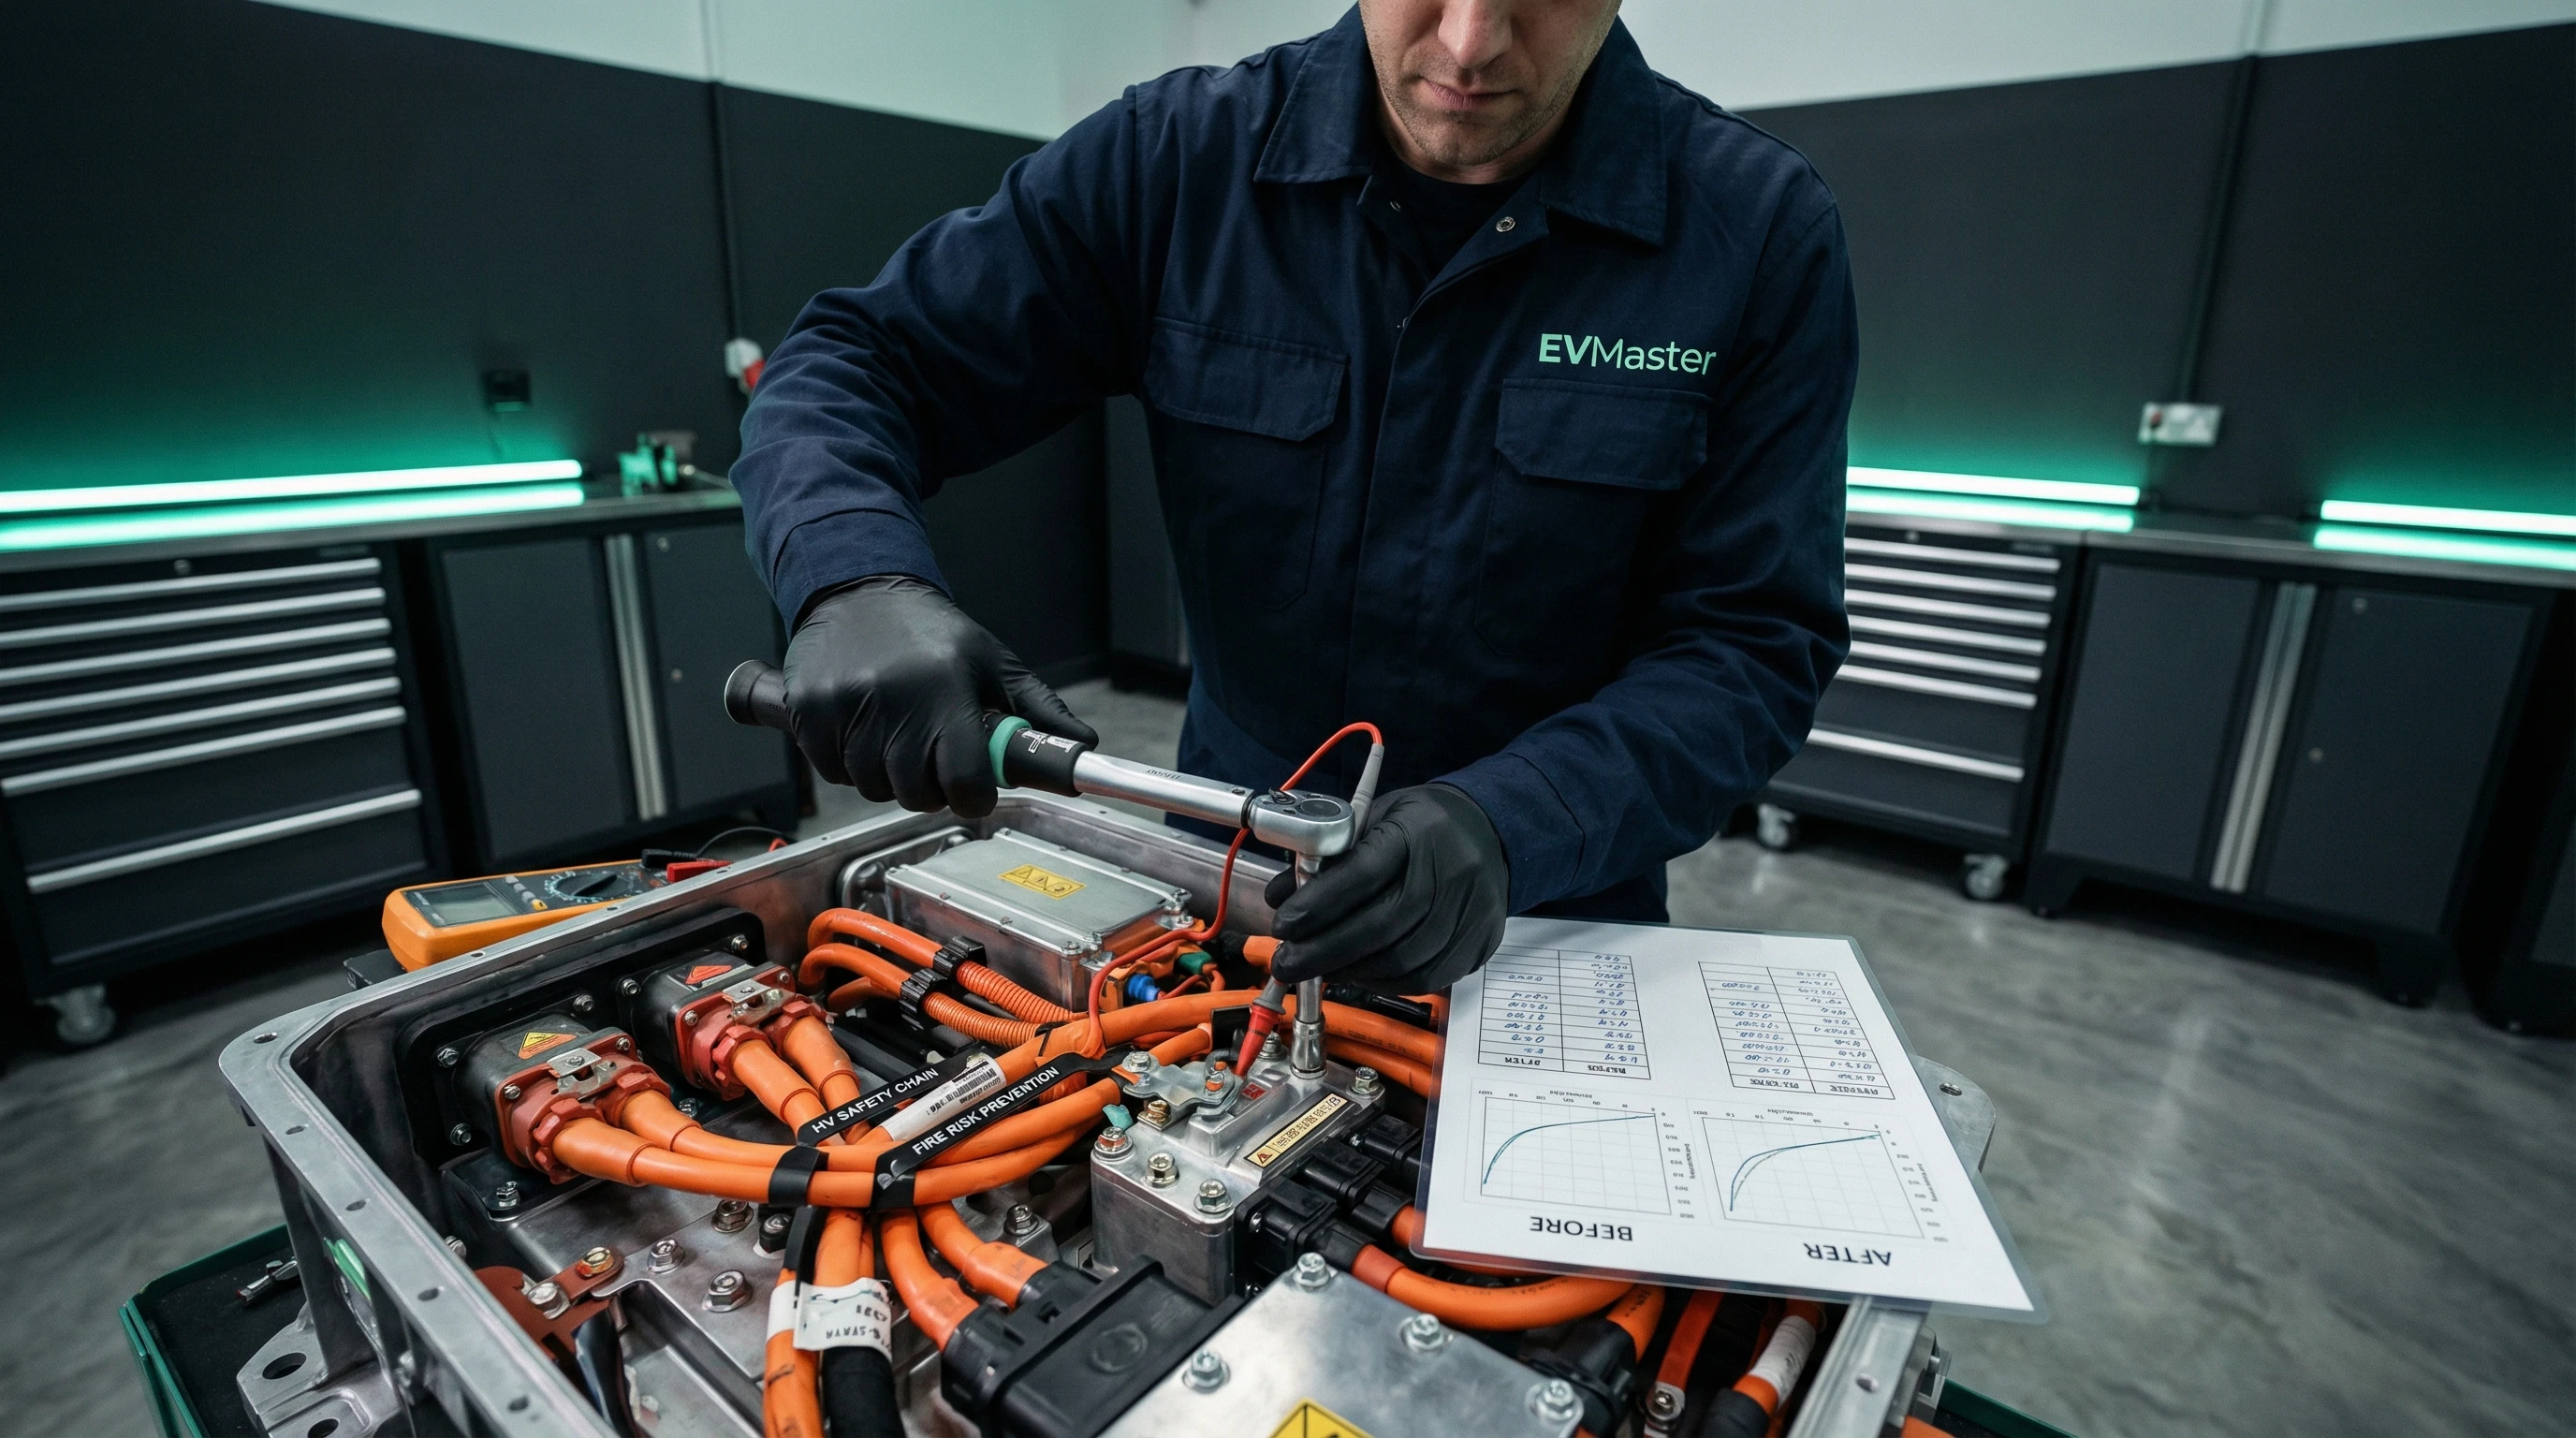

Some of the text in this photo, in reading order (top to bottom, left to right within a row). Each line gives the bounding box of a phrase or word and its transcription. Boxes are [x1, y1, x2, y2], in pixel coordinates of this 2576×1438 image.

[1539, 333, 1717, 374] EVMaster
[812, 1116, 835, 1134] HV
[839, 1088, 893, 1122] SAFETY
[895, 1068, 939, 1093] CHAIN
[912, 1131, 948, 1155] FIRE
[945, 1111, 982, 1136] RISK
[980, 1066, 1060, 1118] PREVENTION
[1530, 1216, 1633, 1241] BEFORE
[1803, 1242, 1893, 1267] AFTER
